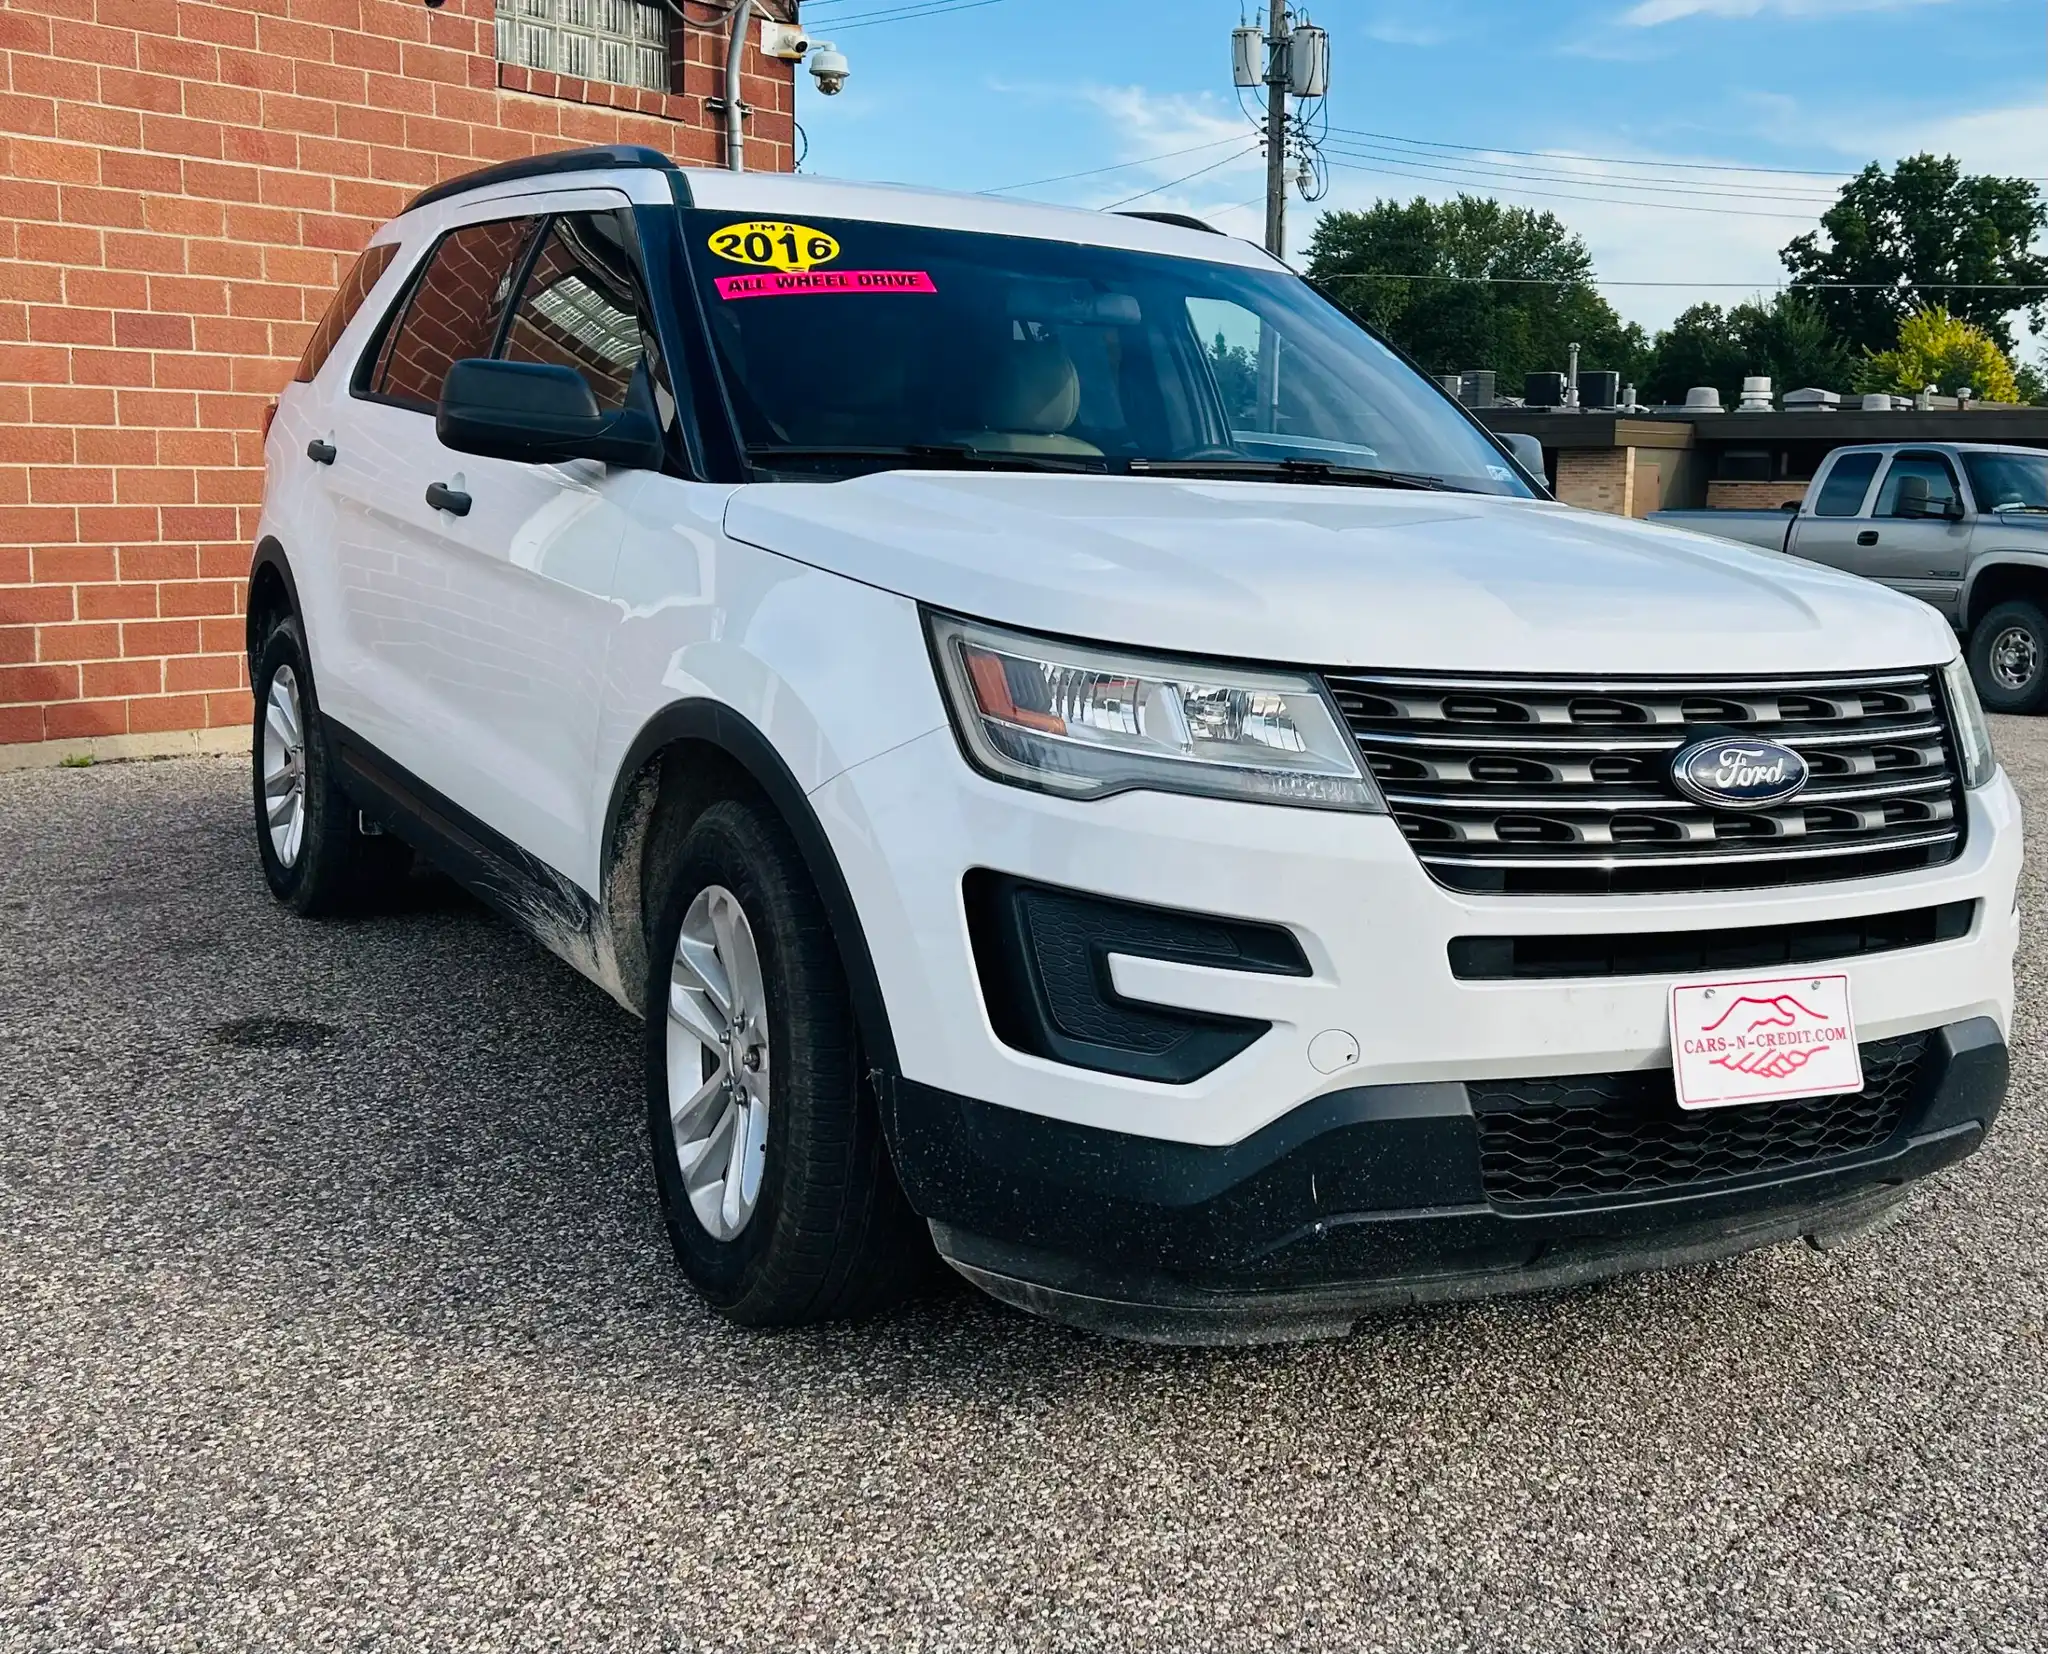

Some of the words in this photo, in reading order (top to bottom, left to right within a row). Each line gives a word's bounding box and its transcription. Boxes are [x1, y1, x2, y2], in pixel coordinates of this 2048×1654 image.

[715, 232, 832, 263] 2016
[728, 279, 767, 292] ALL
[776, 274, 849, 288] WHEEL
[858, 274, 921, 286] DRIVE
[1715, 748, 1786, 788] Ford
[1684, 1027, 1848, 1054] CARS-N-CREDIT.COM
